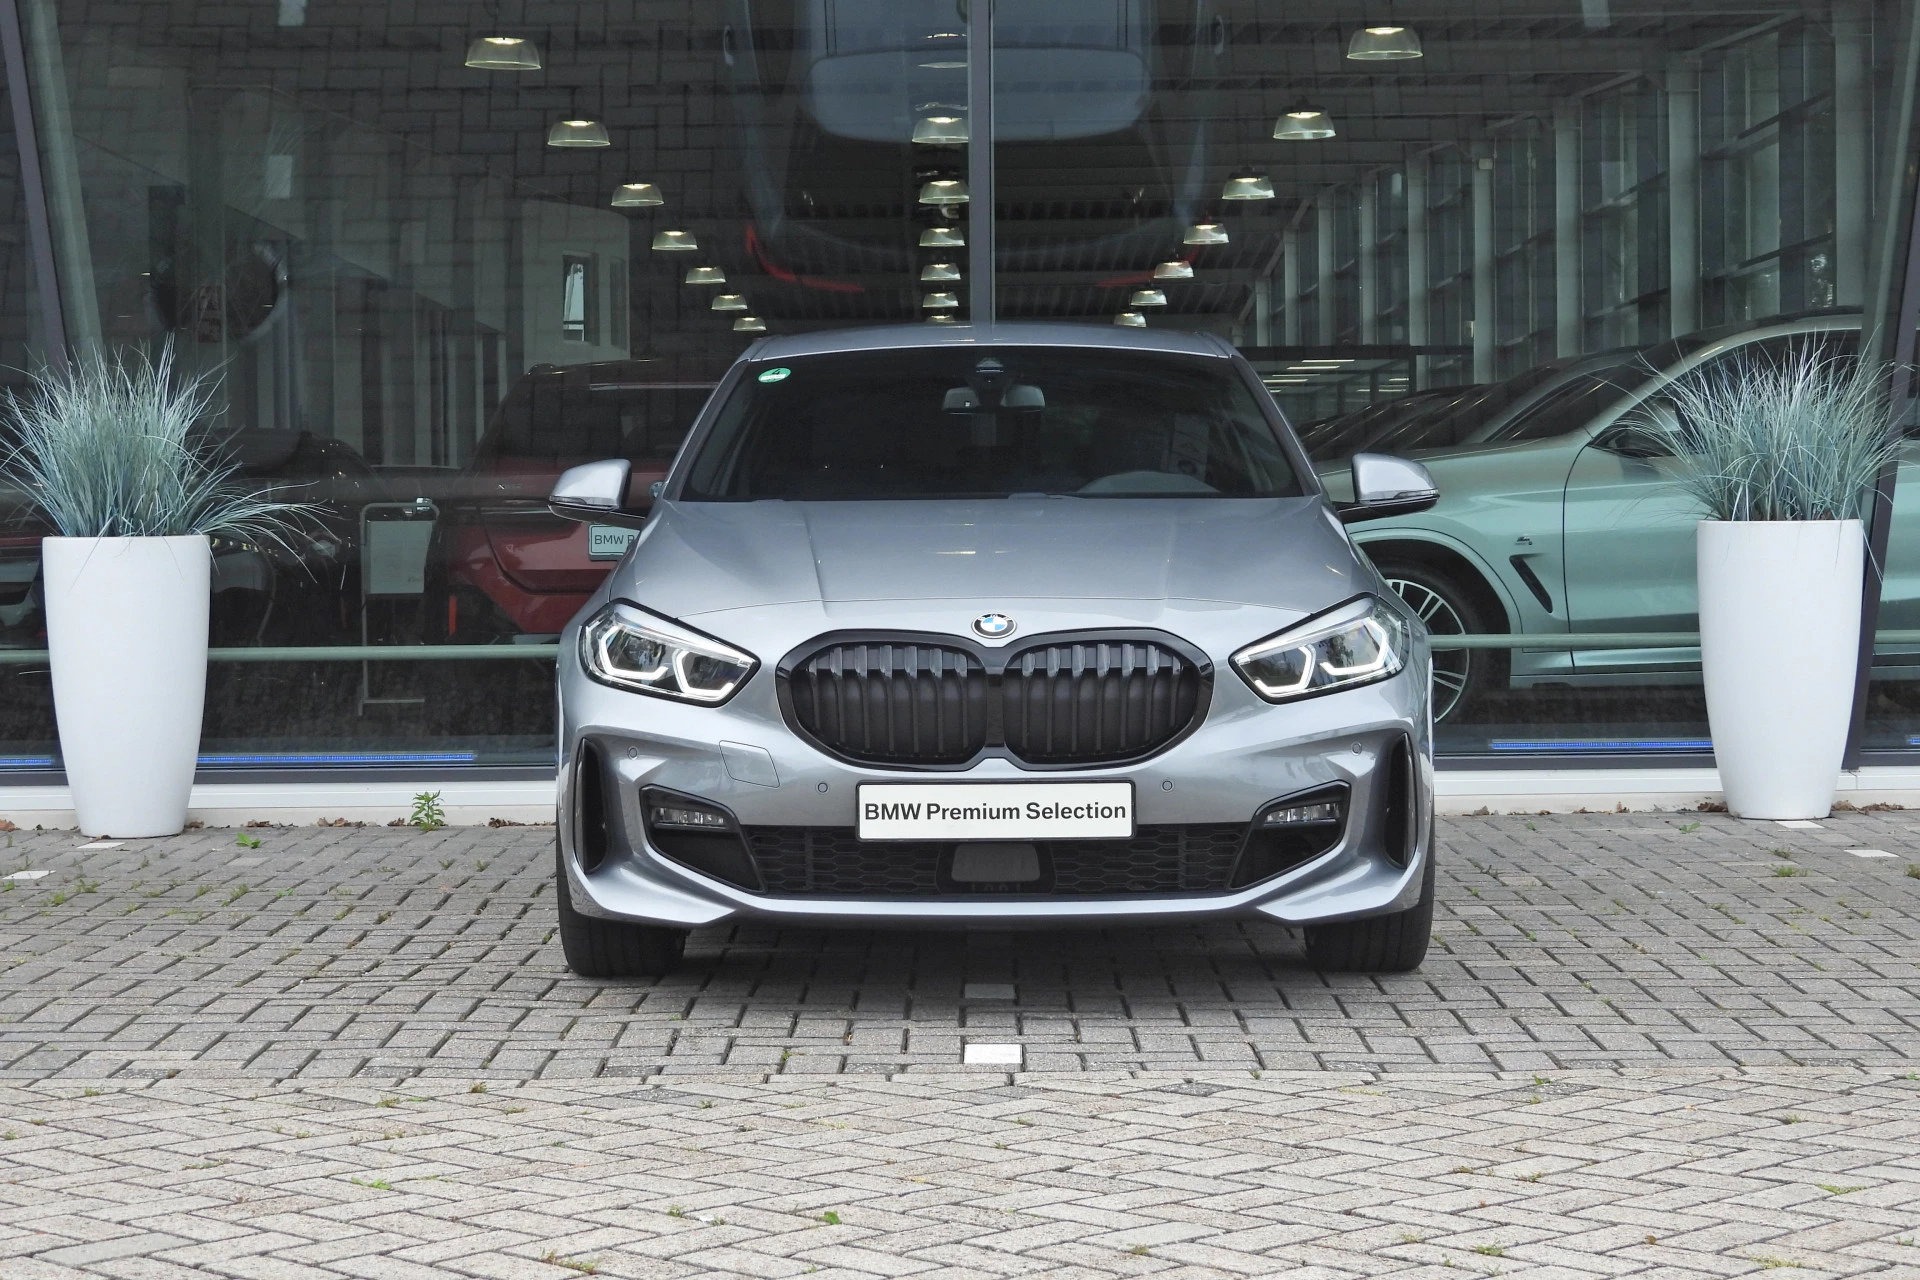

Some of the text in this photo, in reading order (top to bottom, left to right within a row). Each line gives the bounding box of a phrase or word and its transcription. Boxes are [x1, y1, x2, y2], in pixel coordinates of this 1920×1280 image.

[594, 534, 625, 545] BMW
[865, 802, 1127, 821] BMW Premium Selection
